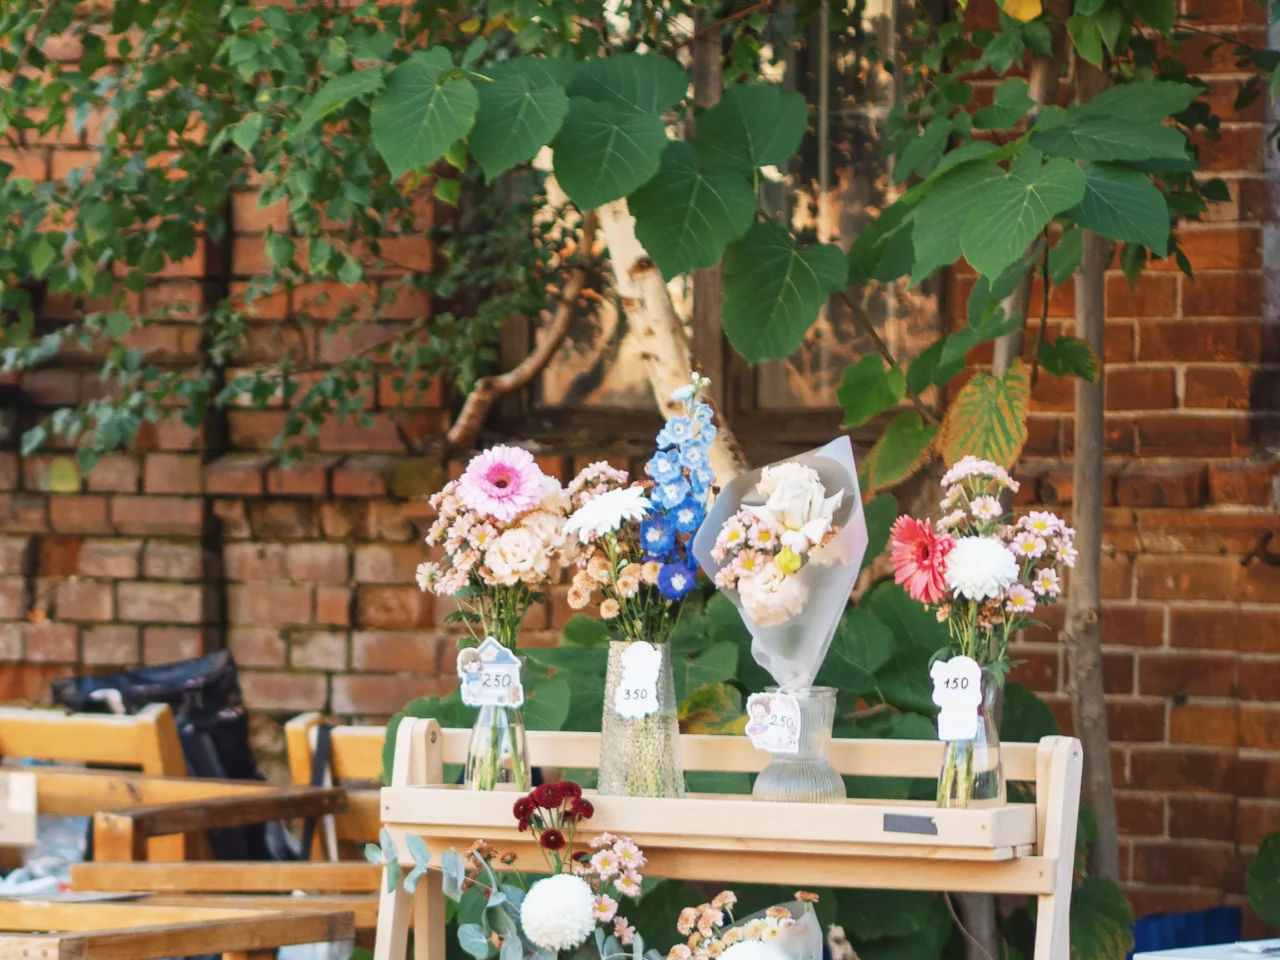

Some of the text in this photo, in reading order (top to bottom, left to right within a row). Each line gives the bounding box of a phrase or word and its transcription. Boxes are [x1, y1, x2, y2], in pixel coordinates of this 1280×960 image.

[482, 673, 512, 687] 250
[943, 676, 969, 690] 150
[622, 688, 648, 700] 350
[769, 714, 795, 729] 250
